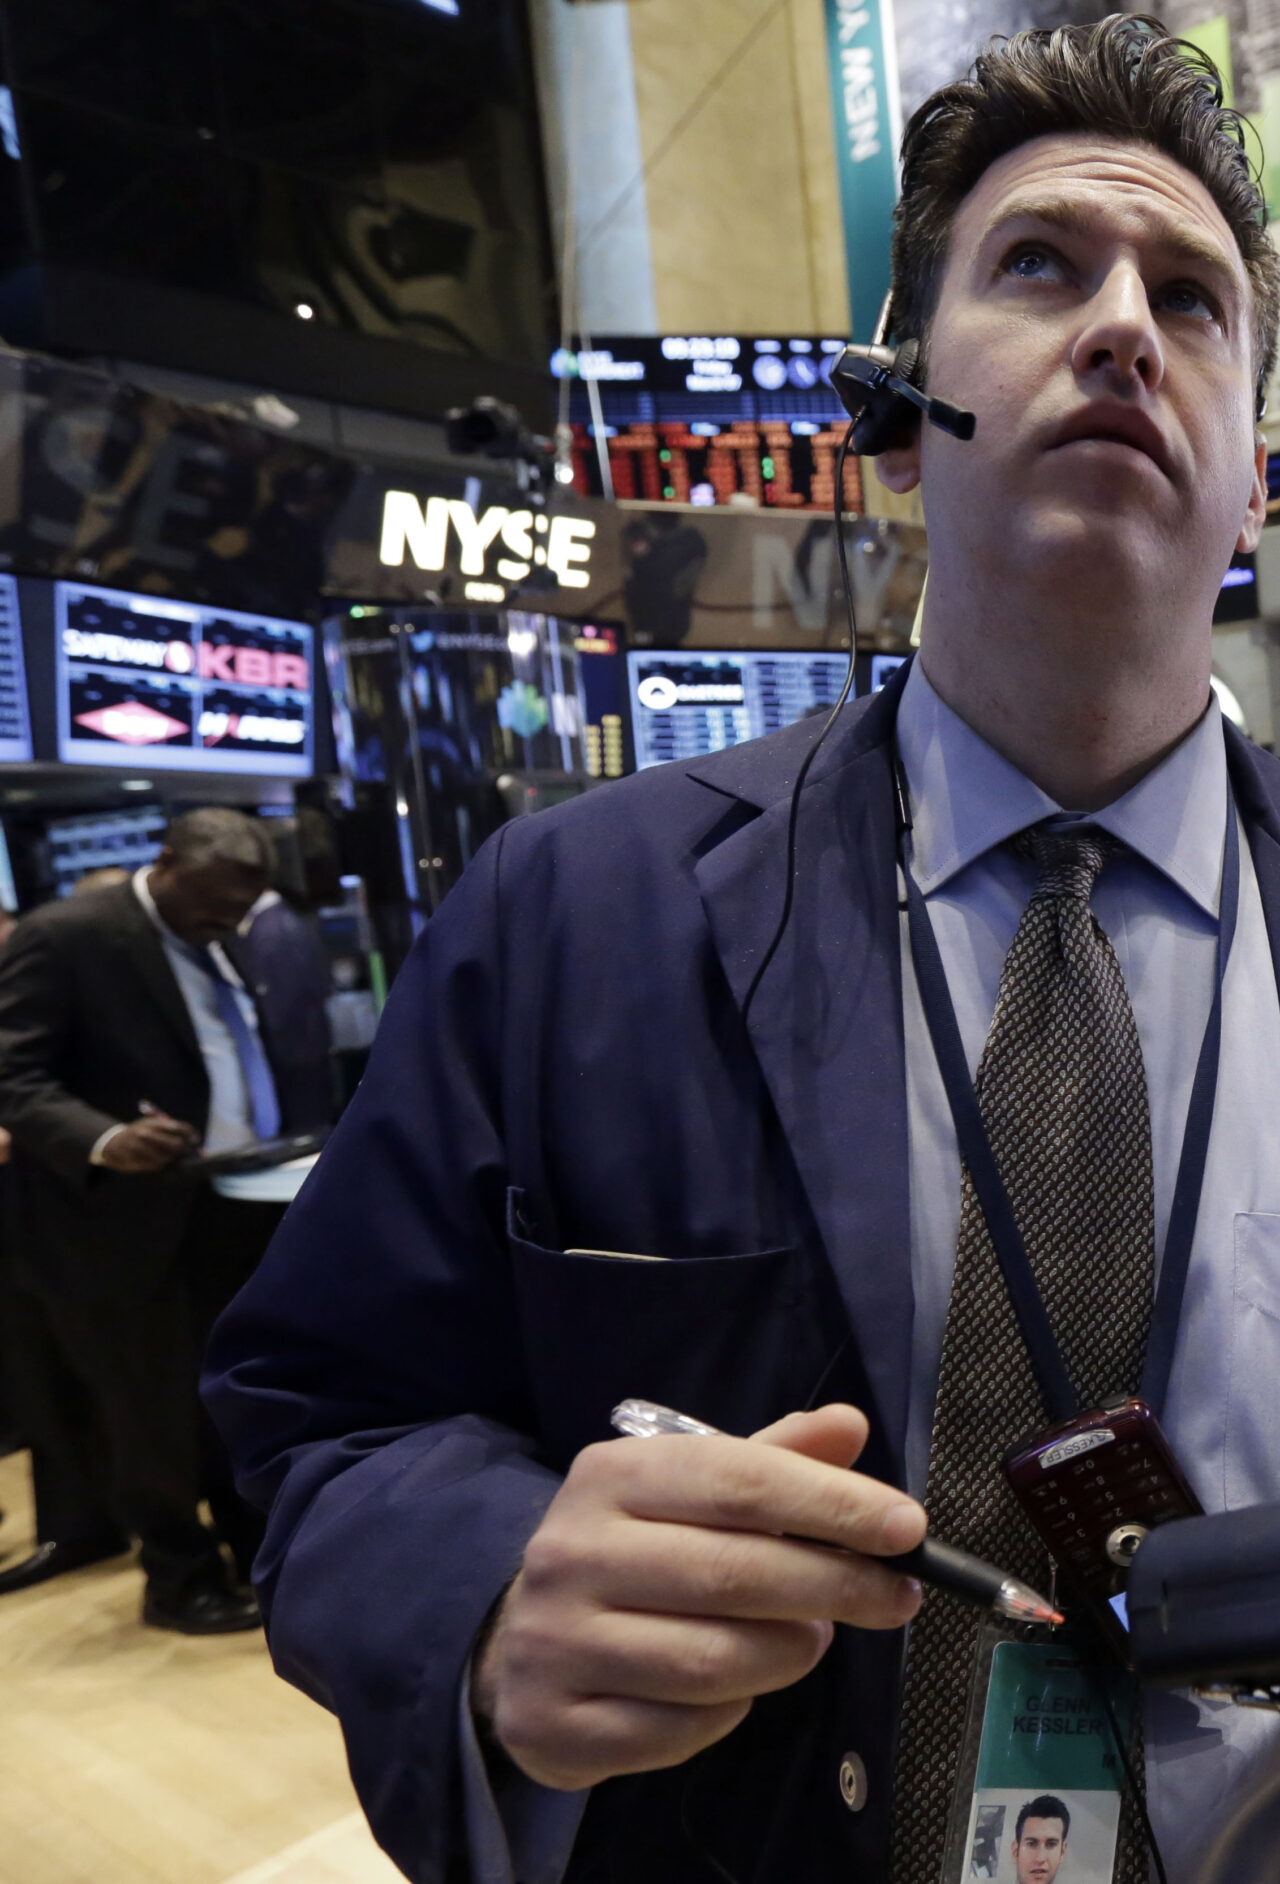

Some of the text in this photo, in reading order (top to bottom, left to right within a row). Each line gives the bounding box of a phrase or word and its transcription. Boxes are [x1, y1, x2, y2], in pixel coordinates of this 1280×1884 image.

[840, 47, 881, 163] NEW
[380, 490, 596, 588] NYSE
[197, 641, 310, 691] KBR
[1047, 1436, 1095, 1462] KESSLER
[1026, 1695, 1092, 1714] GLENN
[1013, 1715, 1104, 1735] KESSLER
